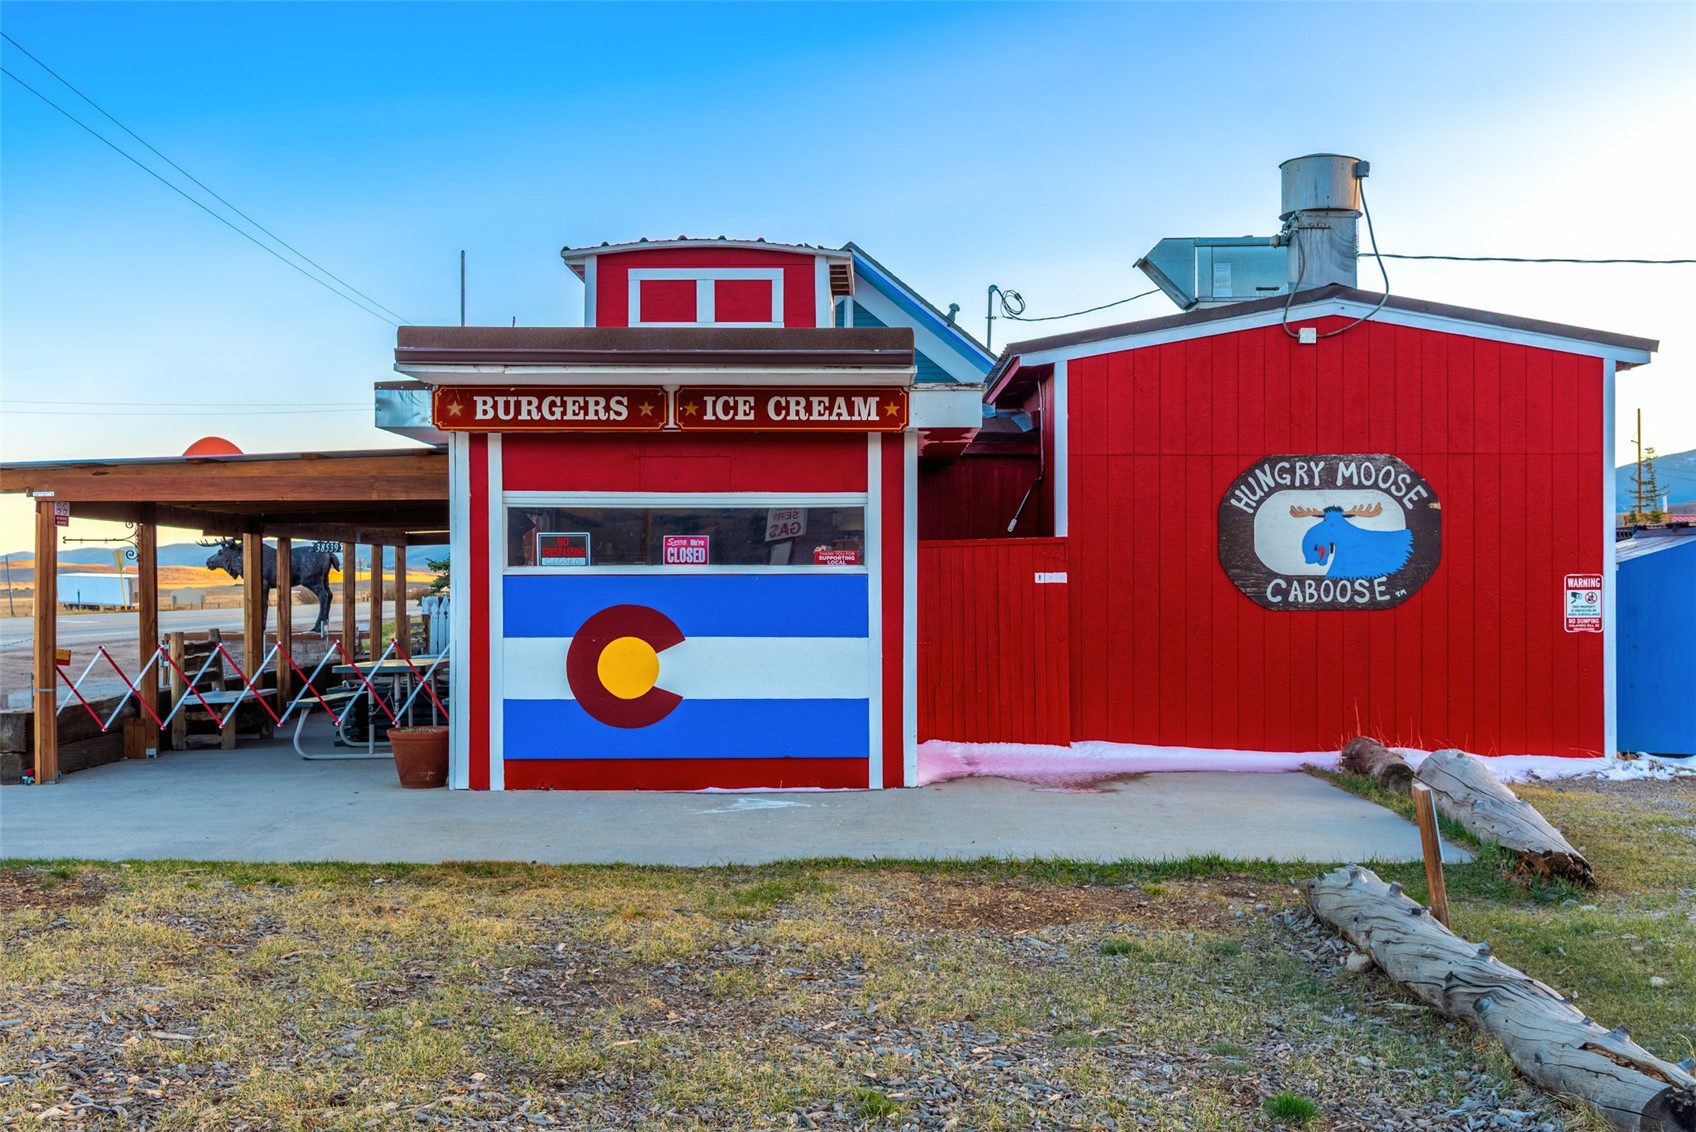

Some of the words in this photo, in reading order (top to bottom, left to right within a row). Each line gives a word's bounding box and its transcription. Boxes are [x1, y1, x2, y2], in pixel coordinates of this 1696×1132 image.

[473, 396, 629, 421] BURGERS
[703, 396, 755, 421] ICE
[767, 396, 880, 421] CREAM
[1230, 461, 1325, 514] HUNGRY
[1336, 461, 1428, 510] MOOSE
[556, 536, 569, 547] NO
[541, 547, 586, 557] TRESPASSING
[667, 547, 706, 563] CLOSED
[1266, 577, 1391, 604] CABOOSE
[1567, 578, 1601, 588] WARNING
